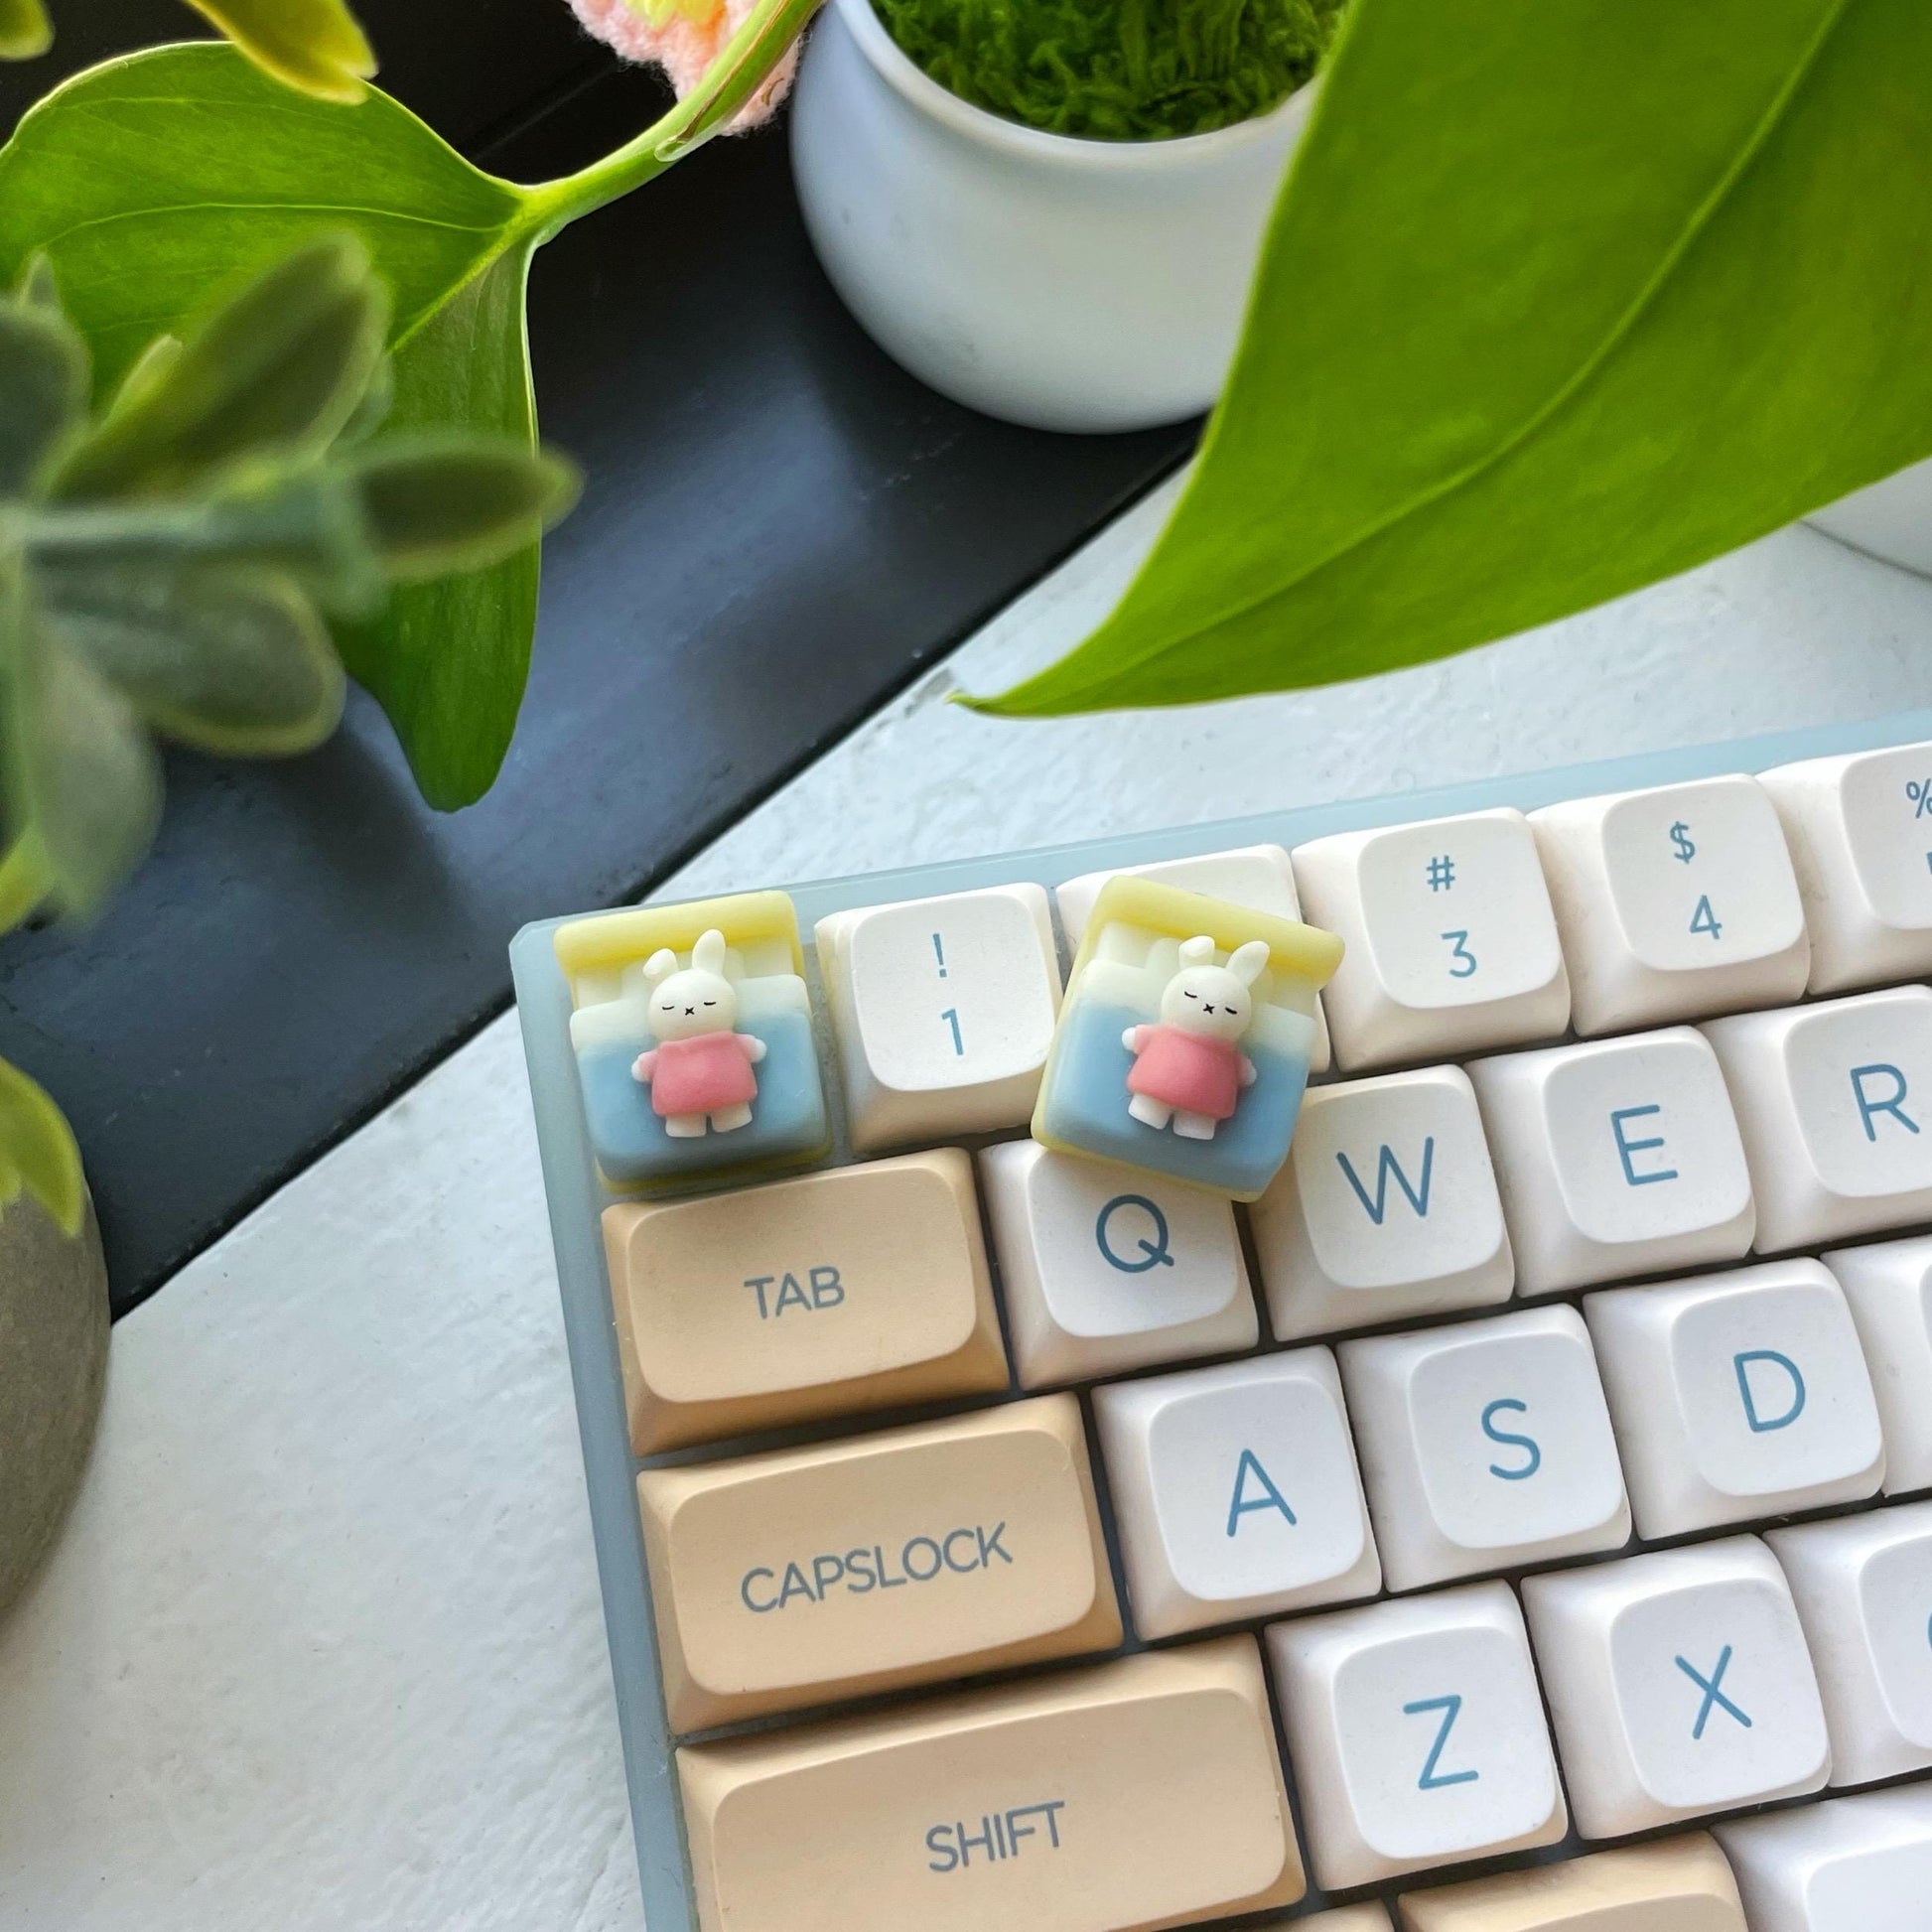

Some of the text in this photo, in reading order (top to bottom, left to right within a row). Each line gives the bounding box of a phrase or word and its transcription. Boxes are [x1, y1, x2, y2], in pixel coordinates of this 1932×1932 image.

[1905, 778, 1932, 819] %
[1427, 855, 1455, 892] #
[1669, 821, 1696, 864] $
[932, 933, 947, 978] !
[1441, 930, 1477, 978] 3
[1690, 895, 1723, 940] 4
[941, 1008, 964, 1055] 1
[1850, 1063, 1920, 1142] R
[1335, 1137, 1434, 1225] W
[1610, 1104, 1679, 1186] E
[1095, 1193, 1174, 1274] Q
[743, 1266, 845, 1319] TAB
[1733, 1350, 1806, 1433] D
[1481, 1398, 1541, 1480] S
[1226, 1449, 1297, 1538] A
[741, 1522, 1013, 1613] CAPSLOCK
[1675, 1645, 1752, 1739] X
[1403, 1694, 1479, 1790] Z
[925, 1800, 1065, 1872] SHIFT
